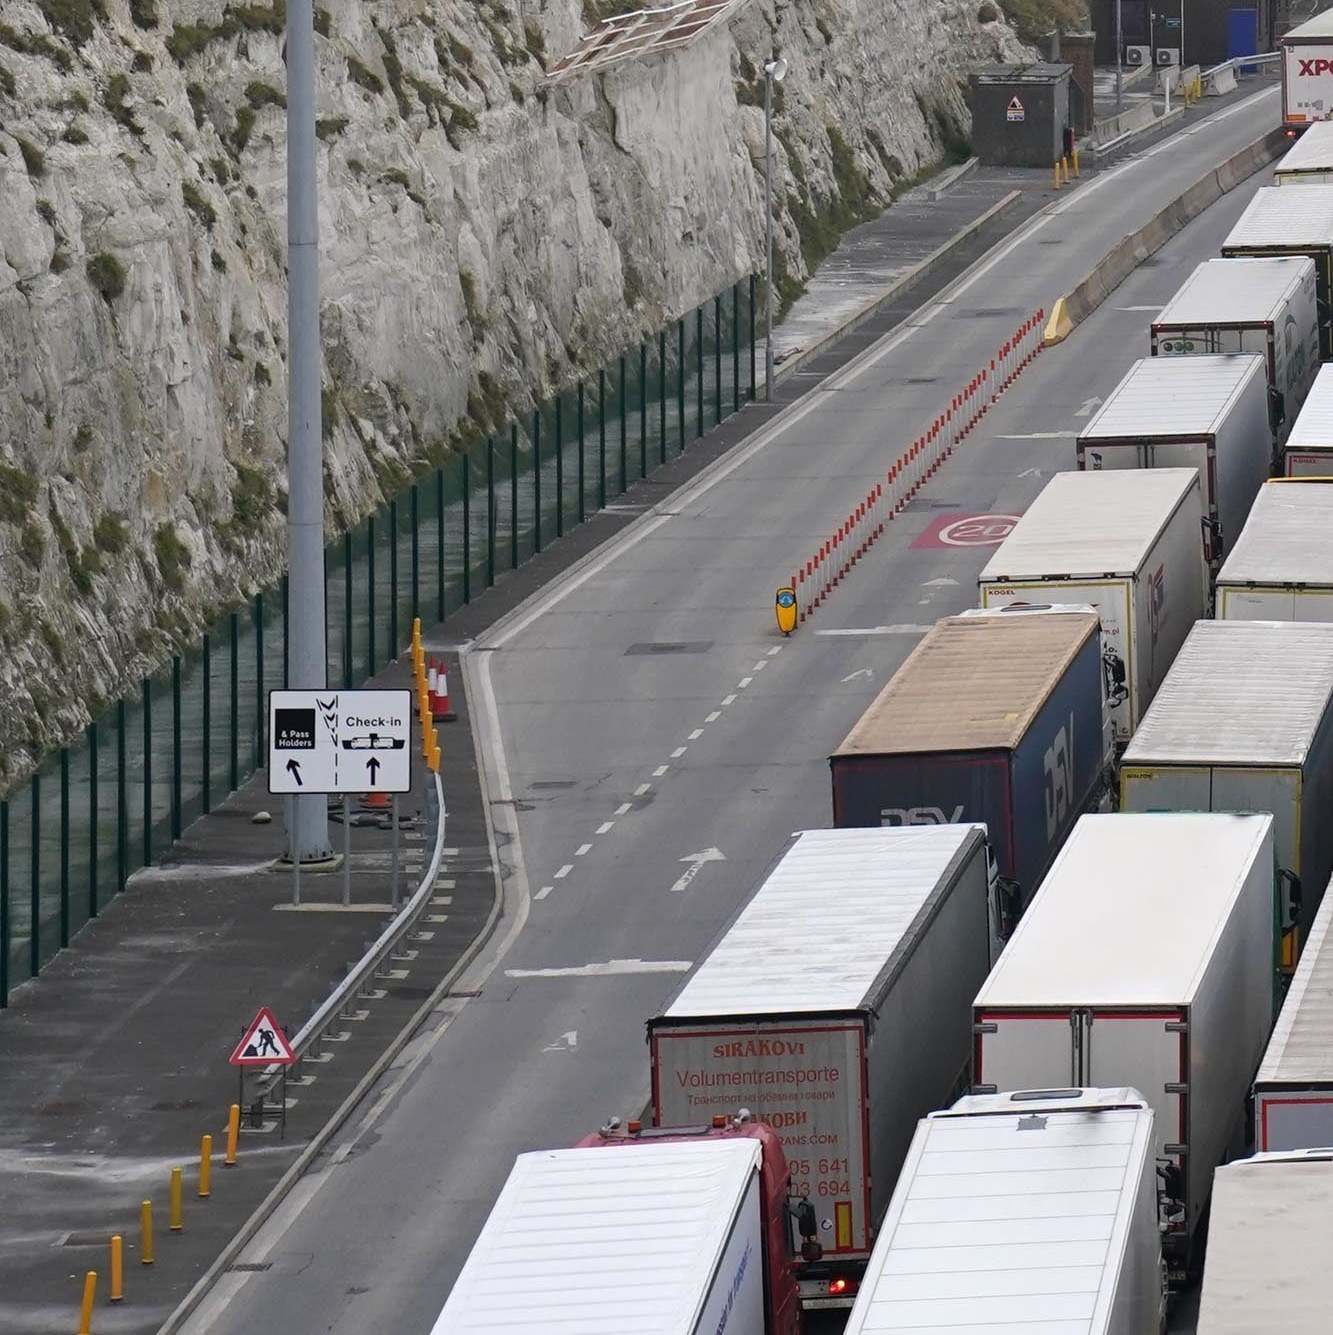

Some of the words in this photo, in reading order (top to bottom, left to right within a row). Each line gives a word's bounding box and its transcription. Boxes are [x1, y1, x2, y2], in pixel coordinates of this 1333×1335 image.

[952, 524, 1014, 538] 20
[346, 717, 402, 727] Check-in
[281, 730, 288, 738] &
[290, 730, 309, 738] Pass
[279, 739, 312, 747] Holders
[712, 1040, 806, 1058] SIRAKOVI
[676, 1066, 840, 1088] Volumentransporte
[818, 1158, 848, 1174] 641
[818, 1181, 850, 1196] 694
